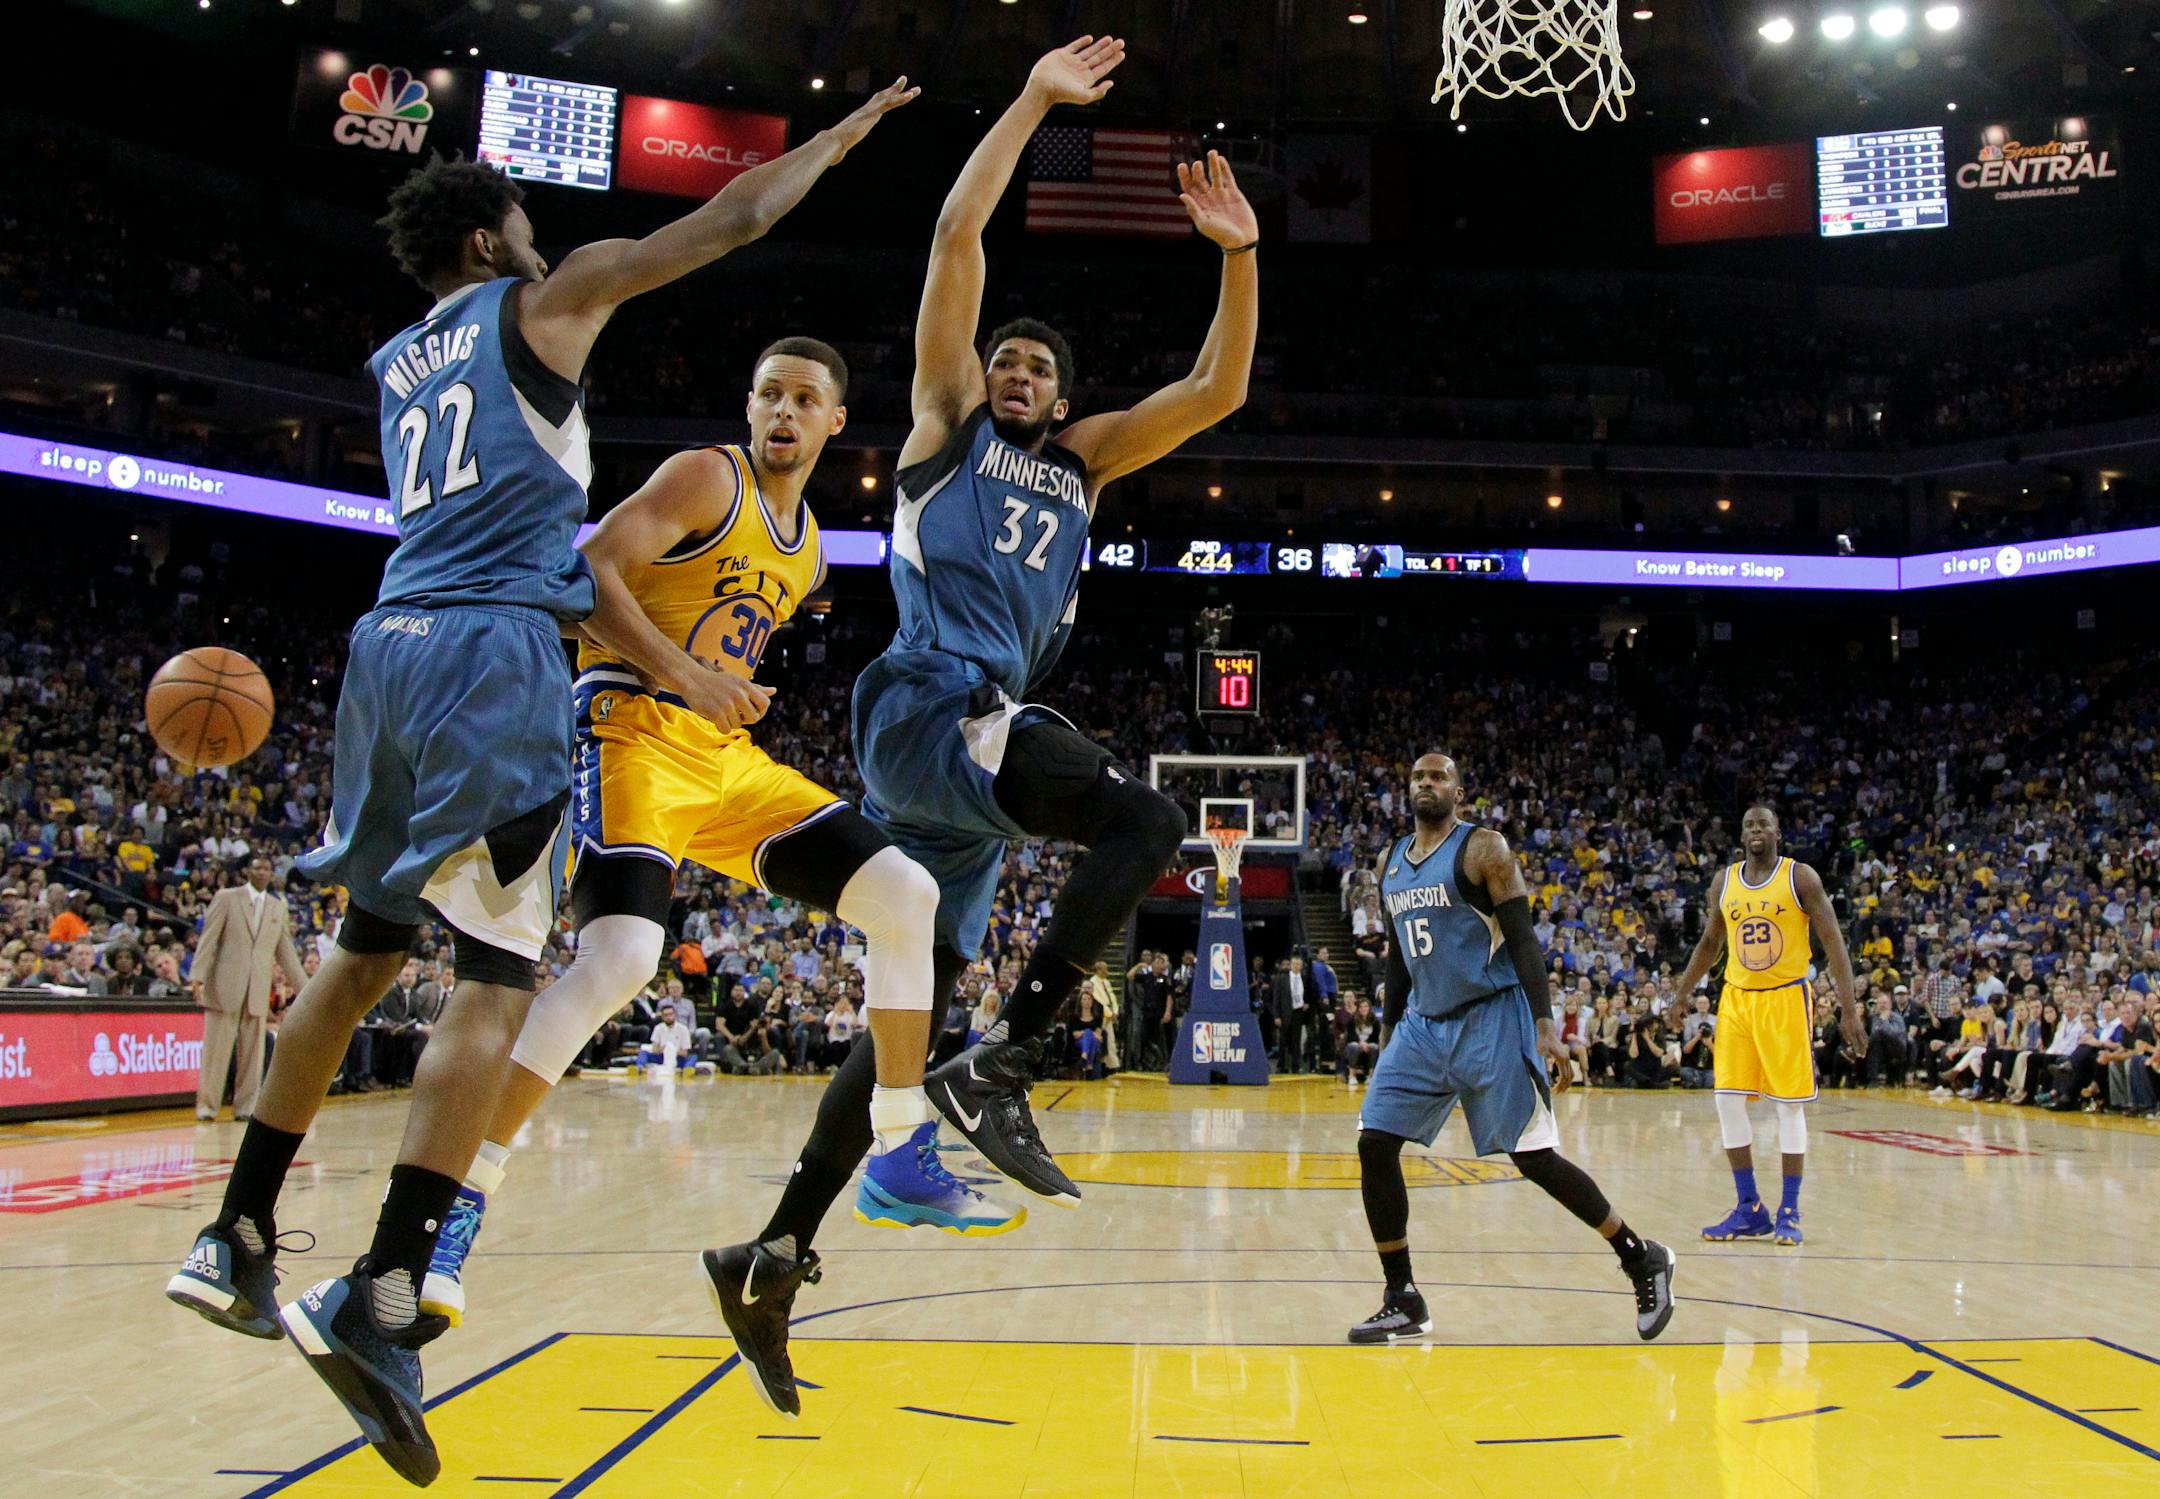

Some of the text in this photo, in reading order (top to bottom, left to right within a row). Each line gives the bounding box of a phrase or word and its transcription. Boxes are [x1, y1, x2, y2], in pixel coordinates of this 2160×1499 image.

[333, 114, 428, 154] CSN
[642, 136, 765, 168] ORACLE
[1956, 151, 2117, 190] CENTRAL
[1670, 182, 1786, 208] ORACLE
[384, 323, 480, 400] WIGGINS
[41, 447, 102, 478] sleep
[399, 381, 480, 519] 22
[325, 499, 370, 520] Know
[993, 495, 1059, 572] 32
[1190, 540, 1221, 553] 2ND
[716, 555, 750, 574] The
[1098, 543, 1313, 571] 42 4:44 36
[1405, 557, 1492, 572] TOL 4 1 TF 1
[1636, 559, 1785, 582] Know Better Sleep
[1943, 556, 1991, 574] sleep
[713, 571, 789, 608] CIT
[721, 602, 771, 669] 30
[1215, 658, 1253, 674] 4:44
[1220, 675, 1249, 707] 10
[1386, 882, 1452, 918] MINNESOTA
[1730, 901, 1787, 921] CITY
[1404, 917, 1434, 958] 15
[1742, 922, 1771, 945] 23
[1212, 1022, 1240, 1037] THIS IS
[1226, 1048, 1246, 1062] PLAY
